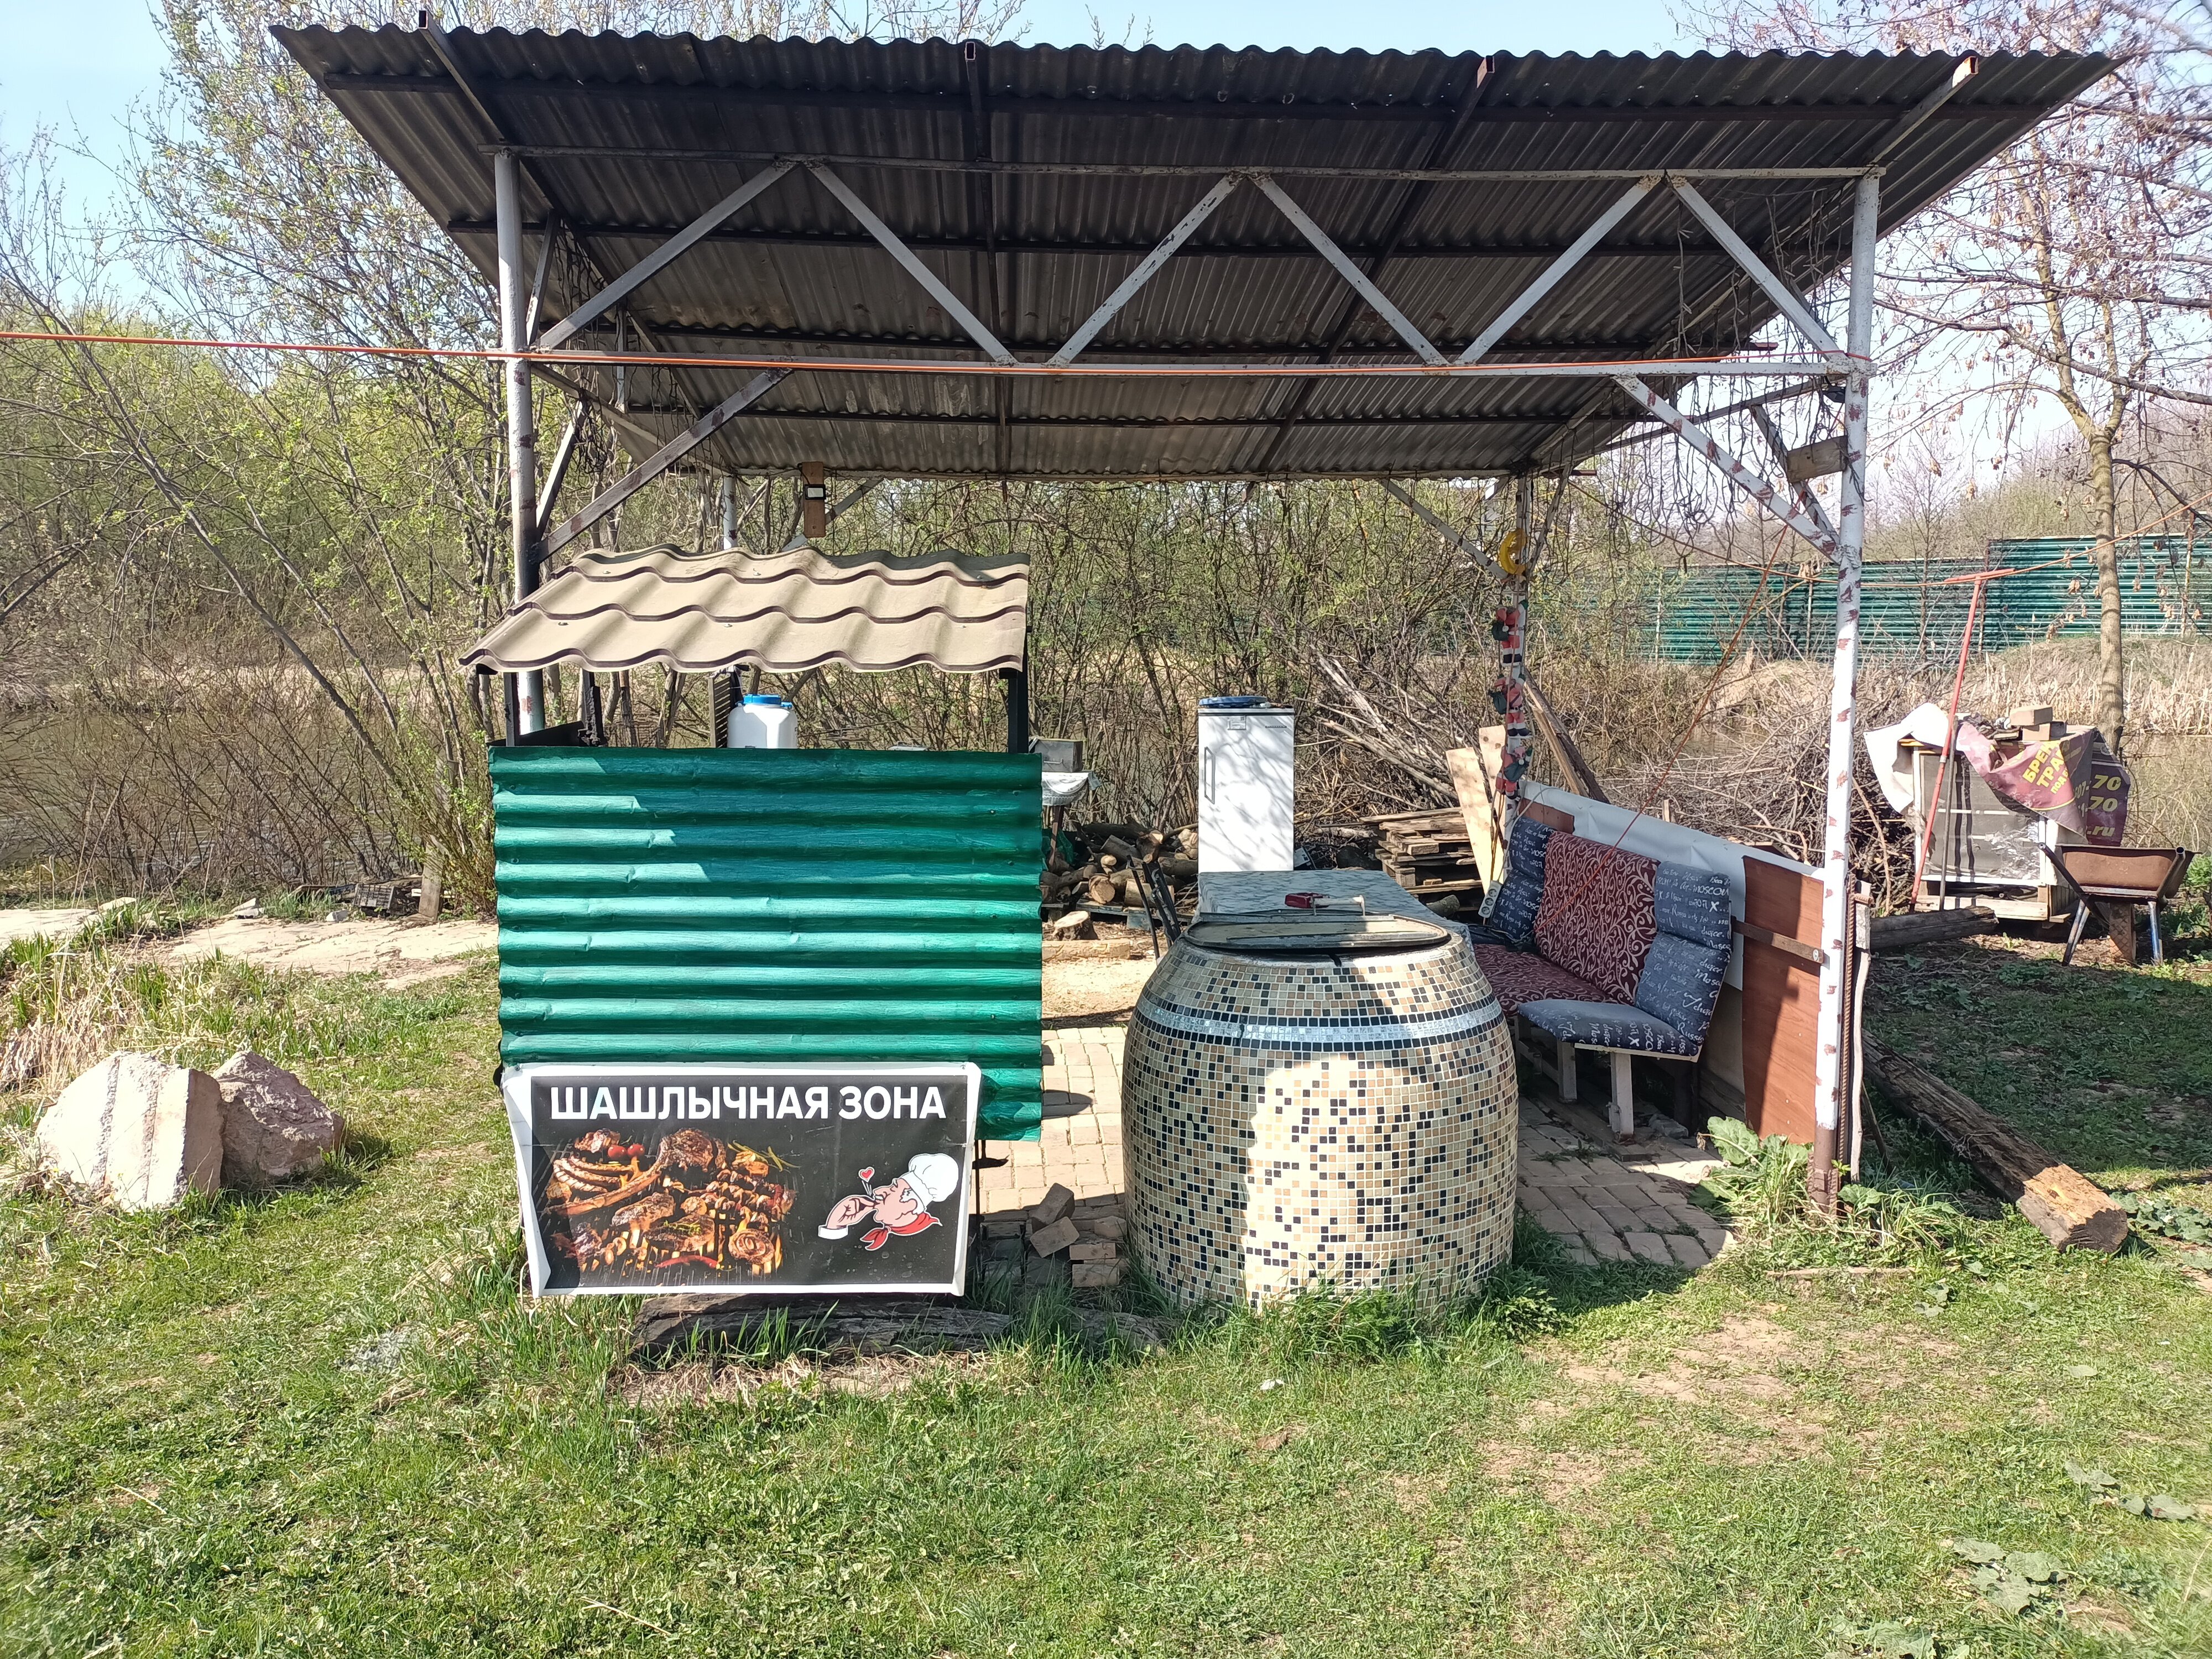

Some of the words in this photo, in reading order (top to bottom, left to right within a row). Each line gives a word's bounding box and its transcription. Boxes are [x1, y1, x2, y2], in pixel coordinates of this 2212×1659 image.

[2088, 796, 2118, 812] 70
[551, 1086, 830, 1120] ШАШЛЫЧНАЯ
[839, 1085, 946, 1120] ЗОНА
